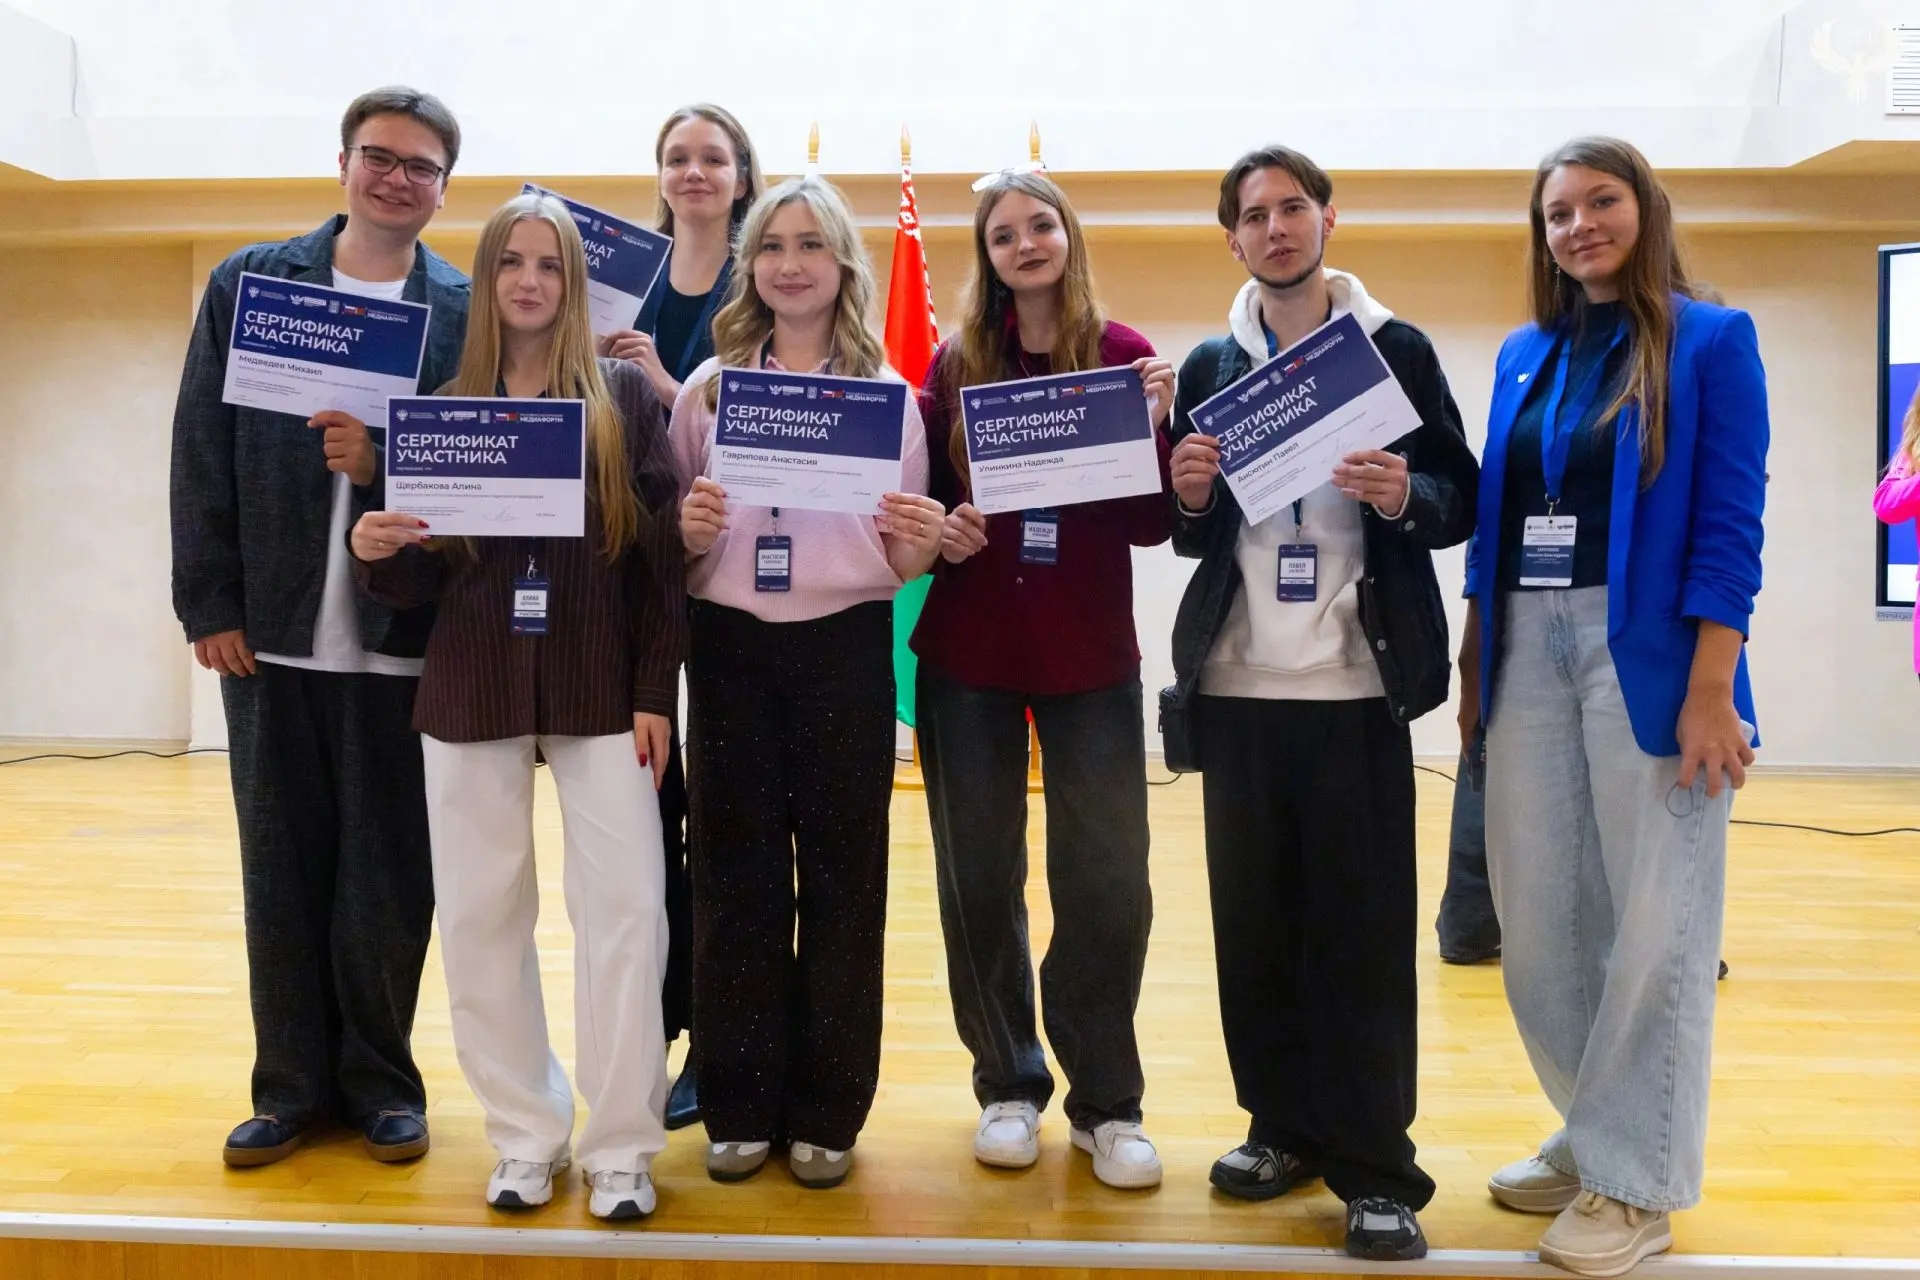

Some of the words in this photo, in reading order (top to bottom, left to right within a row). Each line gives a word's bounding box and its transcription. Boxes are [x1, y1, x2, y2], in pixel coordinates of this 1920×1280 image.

[245, 310, 364, 342] СЕРТИФИКАТ
[243, 323, 350, 355] УЧАСТНИКА
[239, 355, 285, 369] Медведев
[287, 363, 323, 376] Михаил
[726, 404, 842, 426] СЕРТИФИКАТ
[974, 407, 1087, 434] СЕРТИФИКАТ
[1216, 376, 1317, 447] СЕРТИФИКАТ
[725, 419, 829, 440] УЧАСТНИКА
[976, 423, 1079, 448] УЧАСТНИКА
[1221, 397, 1318, 461] УЧАСТНИКА
[396, 433, 518, 449] СЕРТИФИКАТ
[1273, 442, 1299, 461] Павел
[396, 449, 507, 465] УЧАСТНИКА
[770, 455, 818, 466] Анастасия
[1023, 456, 1064, 468] Надежда
[396, 481, 450, 491] Щербакова
[451, 482, 482, 491] Алина
